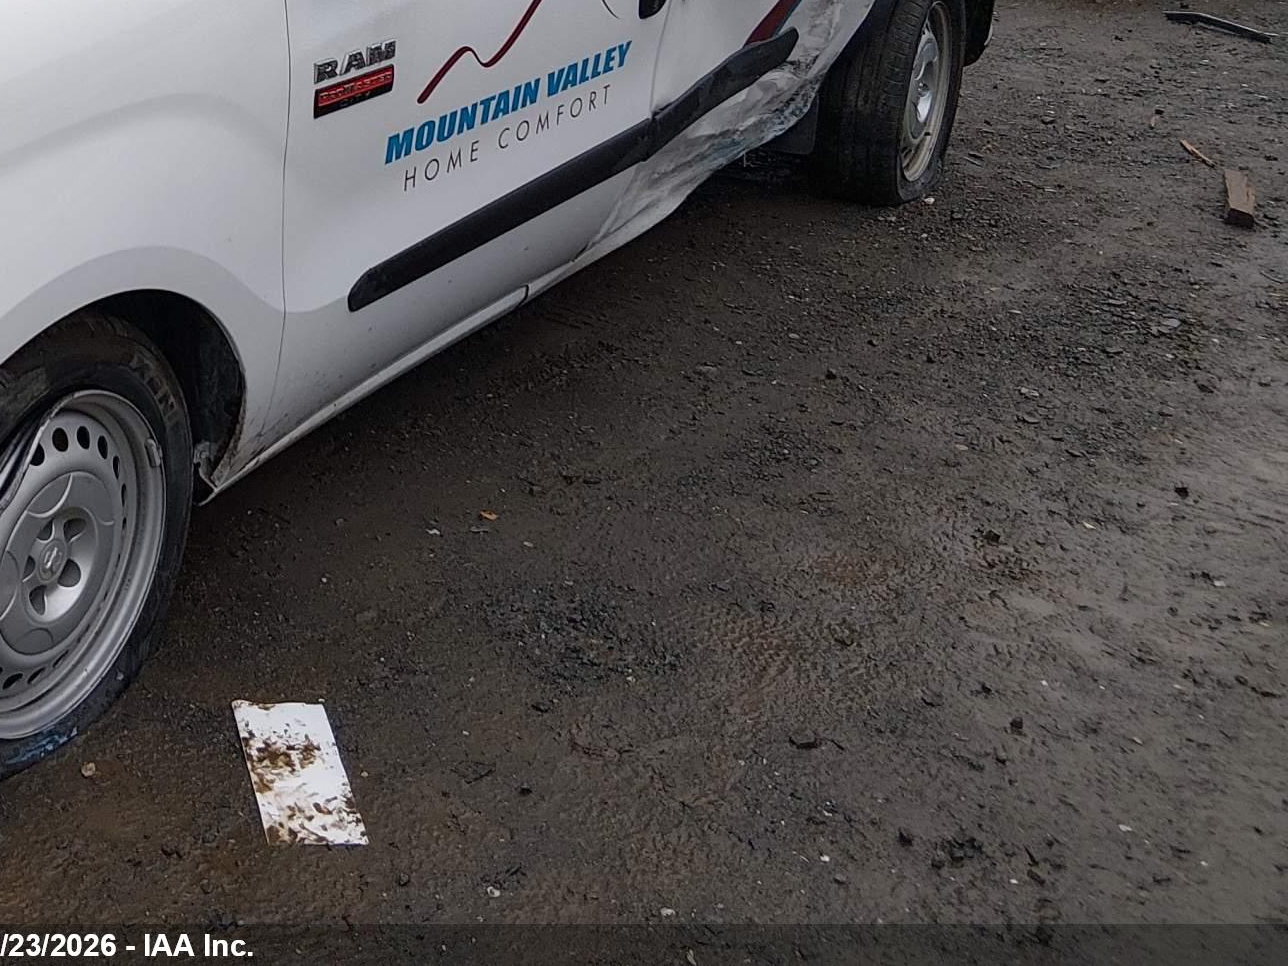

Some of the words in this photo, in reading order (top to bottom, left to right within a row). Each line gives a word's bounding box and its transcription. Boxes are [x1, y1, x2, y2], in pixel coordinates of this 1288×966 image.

[314, 38, 397, 86] RAM
[384, 77, 541, 166] MOUNTAIN
[546, 40, 633, 99] VALLEY
[403, 140, 481, 192] HOME
[497, 84, 612, 151] COMFORT
